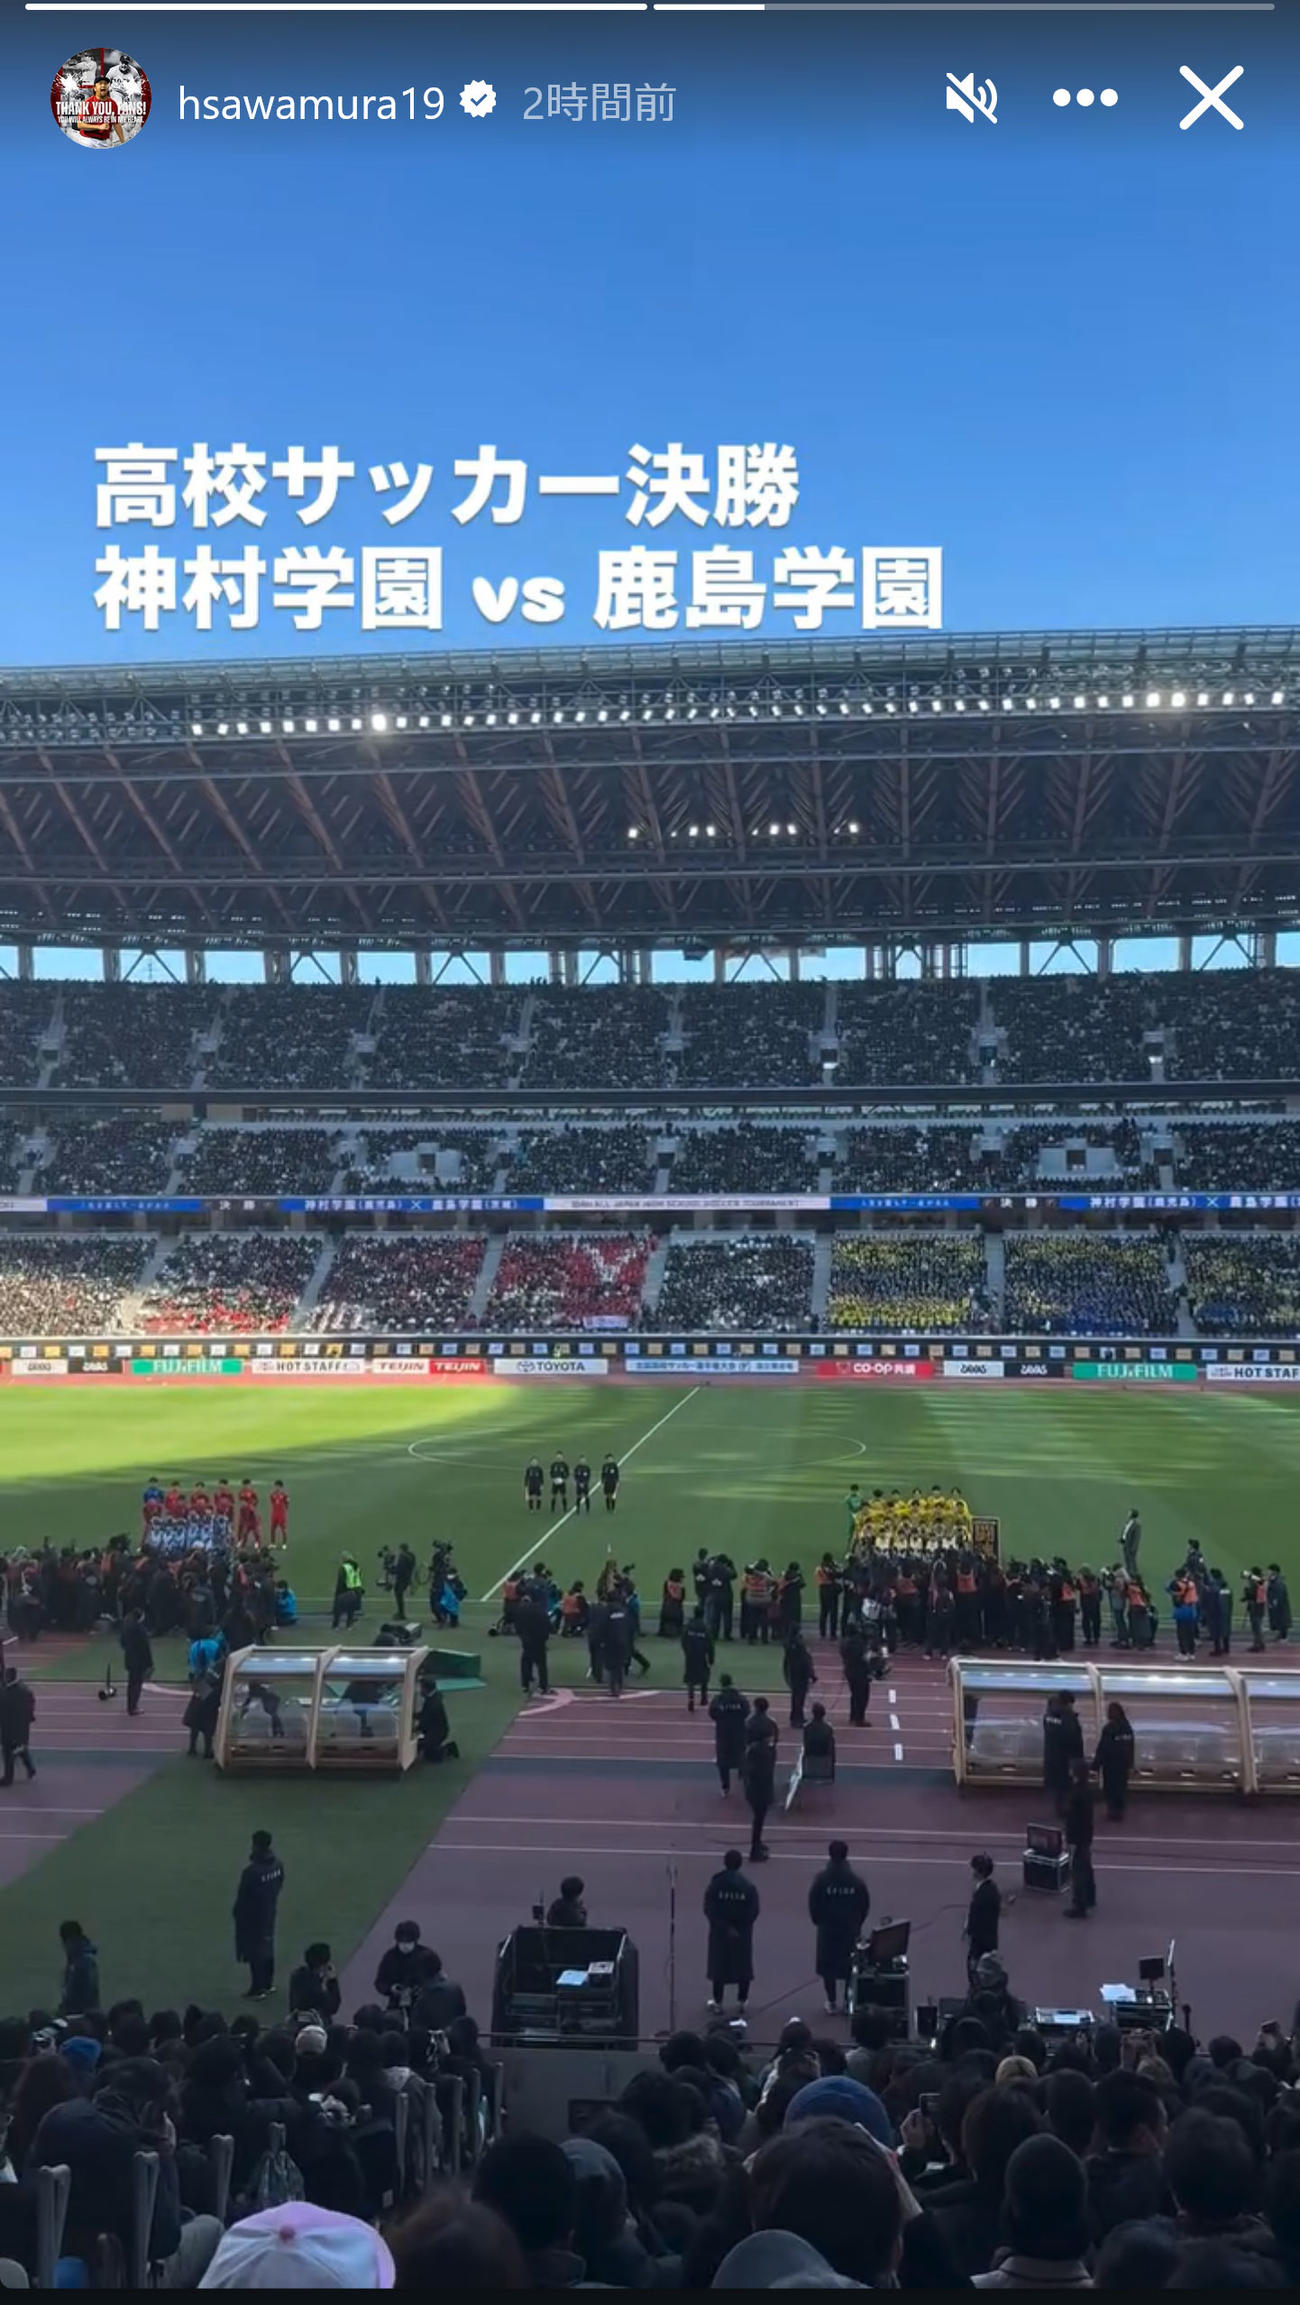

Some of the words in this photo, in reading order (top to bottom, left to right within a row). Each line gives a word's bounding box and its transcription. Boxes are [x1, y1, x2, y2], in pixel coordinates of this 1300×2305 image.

[152, 1358, 223, 1373] FUJIFILM
[276, 1360, 302, 1372] HOT
[378, 1361, 425, 1372] TEIJIN
[434, 1362, 481, 1373] TEIJIN
[537, 1361, 586, 1373] TOYOTA
[1097, 1364, 1174, 1378] FUJIFILM
[1234, 1366, 1262, 1378] HOT
